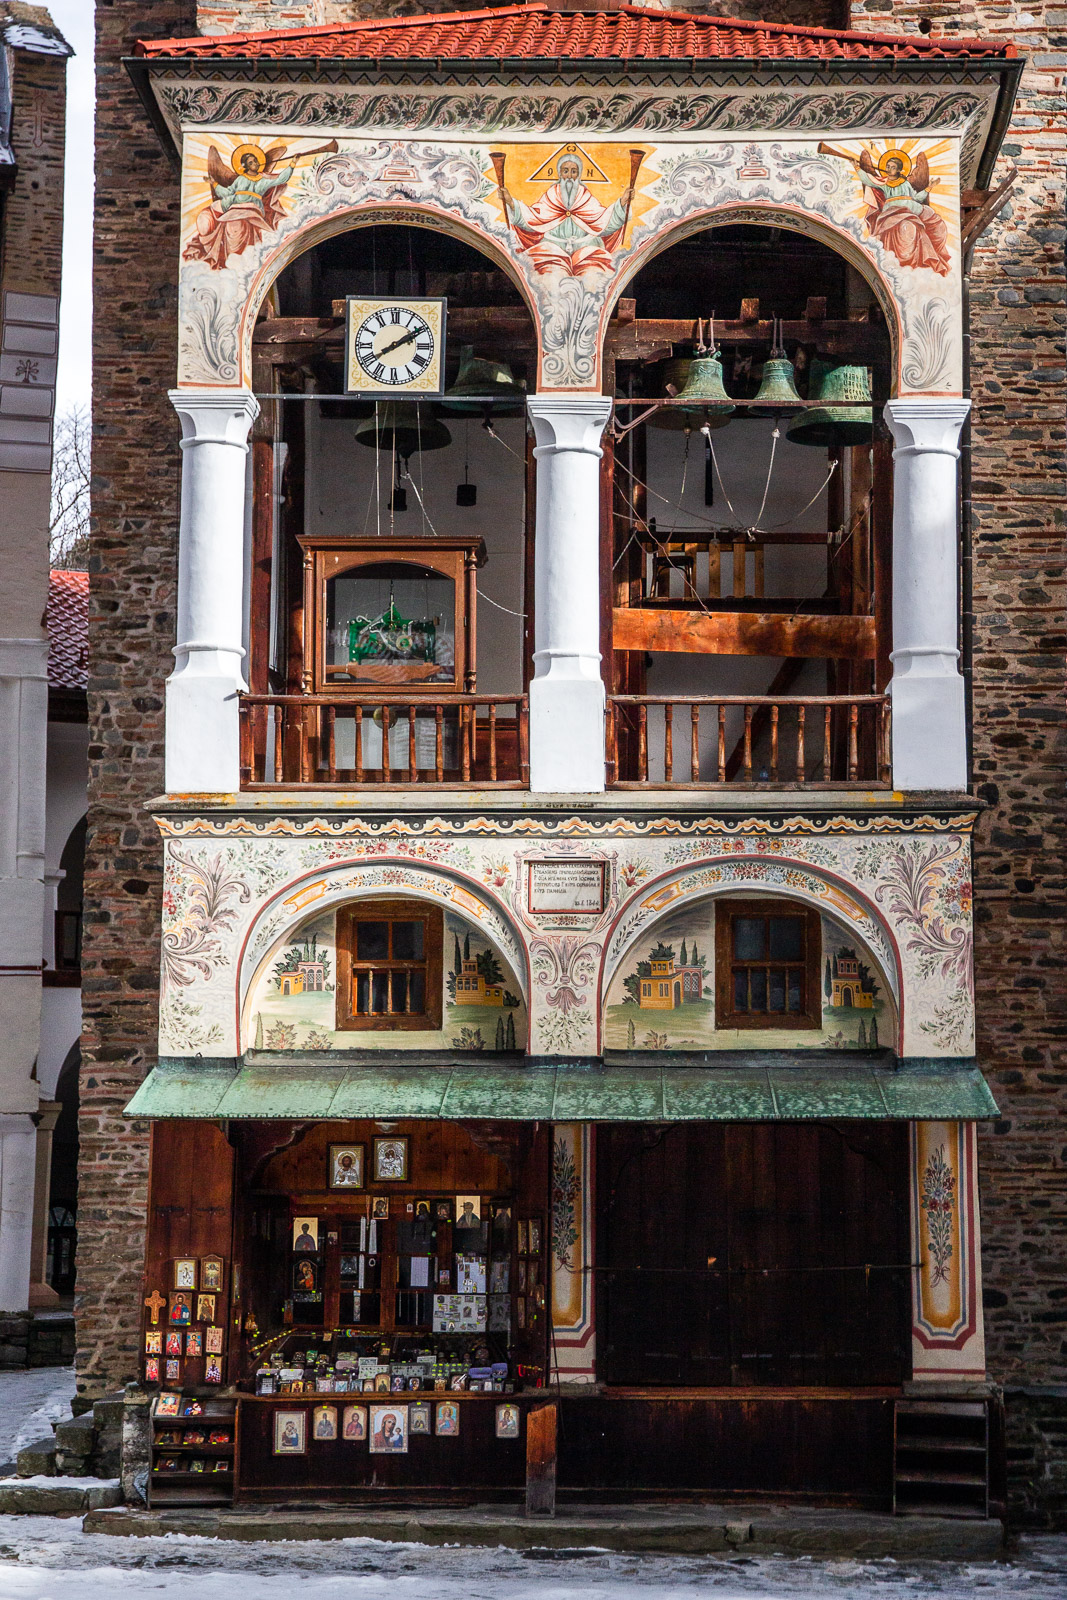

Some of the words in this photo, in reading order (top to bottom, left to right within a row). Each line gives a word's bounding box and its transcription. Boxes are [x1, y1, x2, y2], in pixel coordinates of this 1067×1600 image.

[376, 315, 386, 328] XI
[390, 312, 400, 324] XII
[364, 326, 376, 336] X
[359, 342, 372, 350] IX
[416, 342, 430, 350] III
[362, 352, 377, 368] VIII
[373, 362, 386, 378] VII
[390, 368, 398, 380] VI
[404, 364, 414, 378] V
